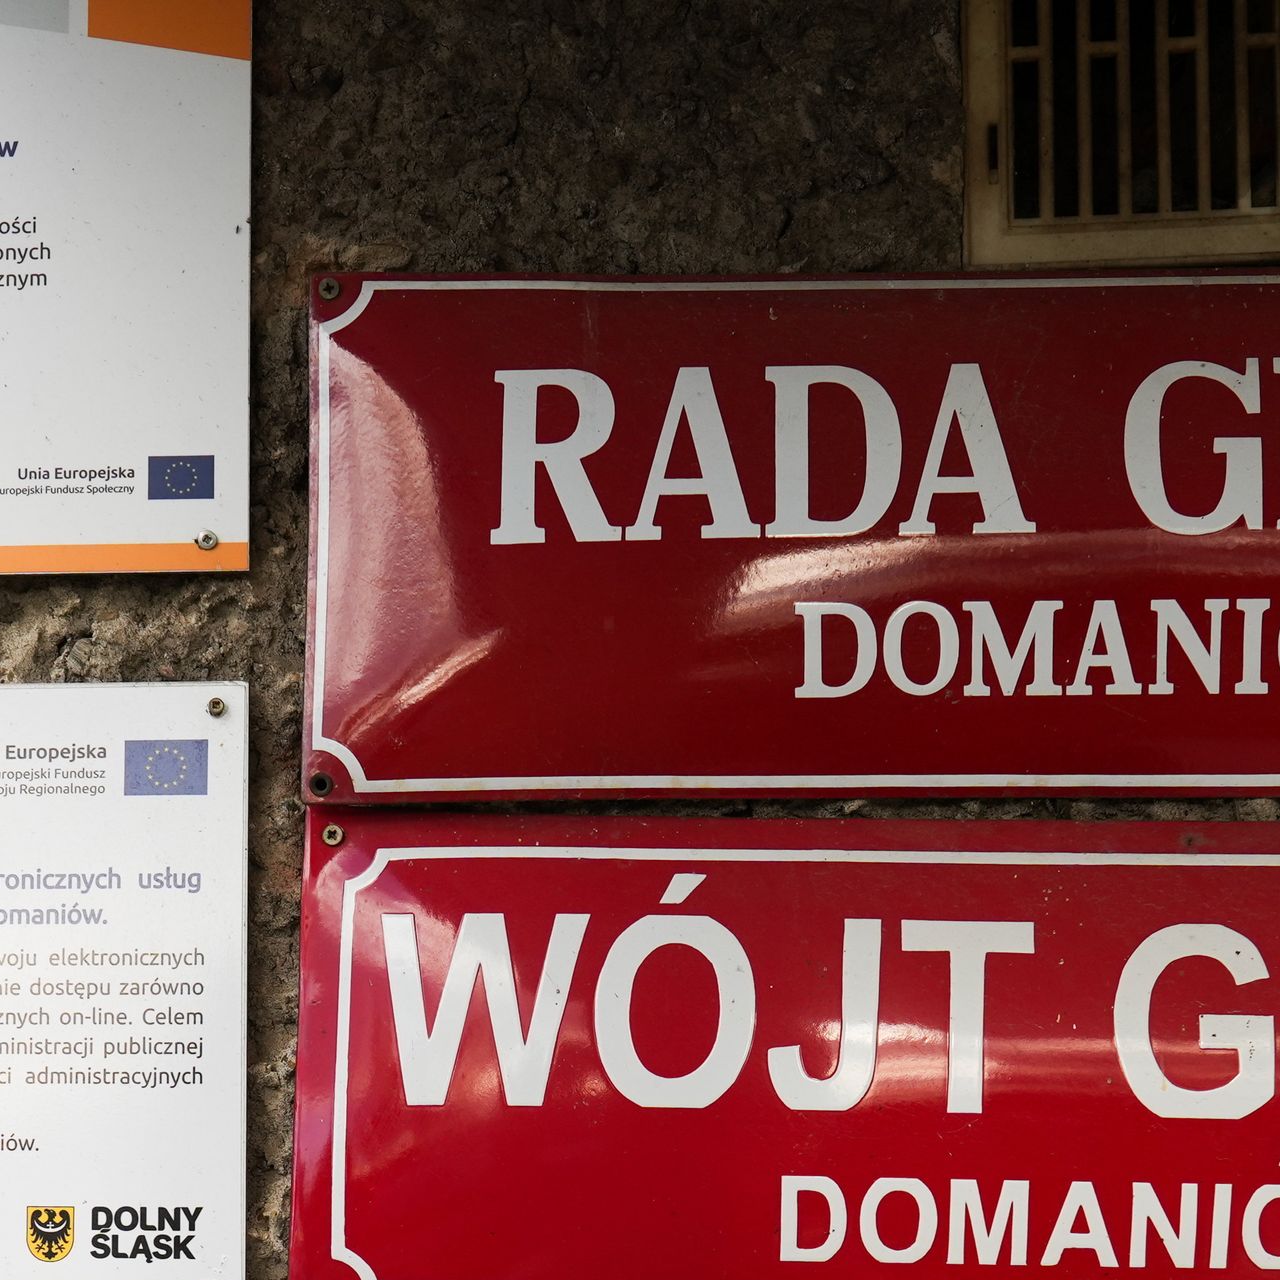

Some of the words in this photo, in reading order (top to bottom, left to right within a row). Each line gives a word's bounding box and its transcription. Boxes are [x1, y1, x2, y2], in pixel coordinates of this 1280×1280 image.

[489, 363, 1037, 545] RADA
[17, 466, 51, 481] Unia
[54, 465, 136, 482] Europejska
[44, 484, 85, 495] Fundusz
[86, 483, 135, 496] Społeczny
[5, 742, 107, 763] Europejska
[53, 767, 106, 780] Fundusz
[137, 865, 202, 895] usług
[48, 946, 206, 971] elektronicznych
[381, 872, 1036, 1115] WÓJT
[91, 1205, 203, 1231] DOLNY
[90, 1228, 196, 1263] ŚLĄSK
